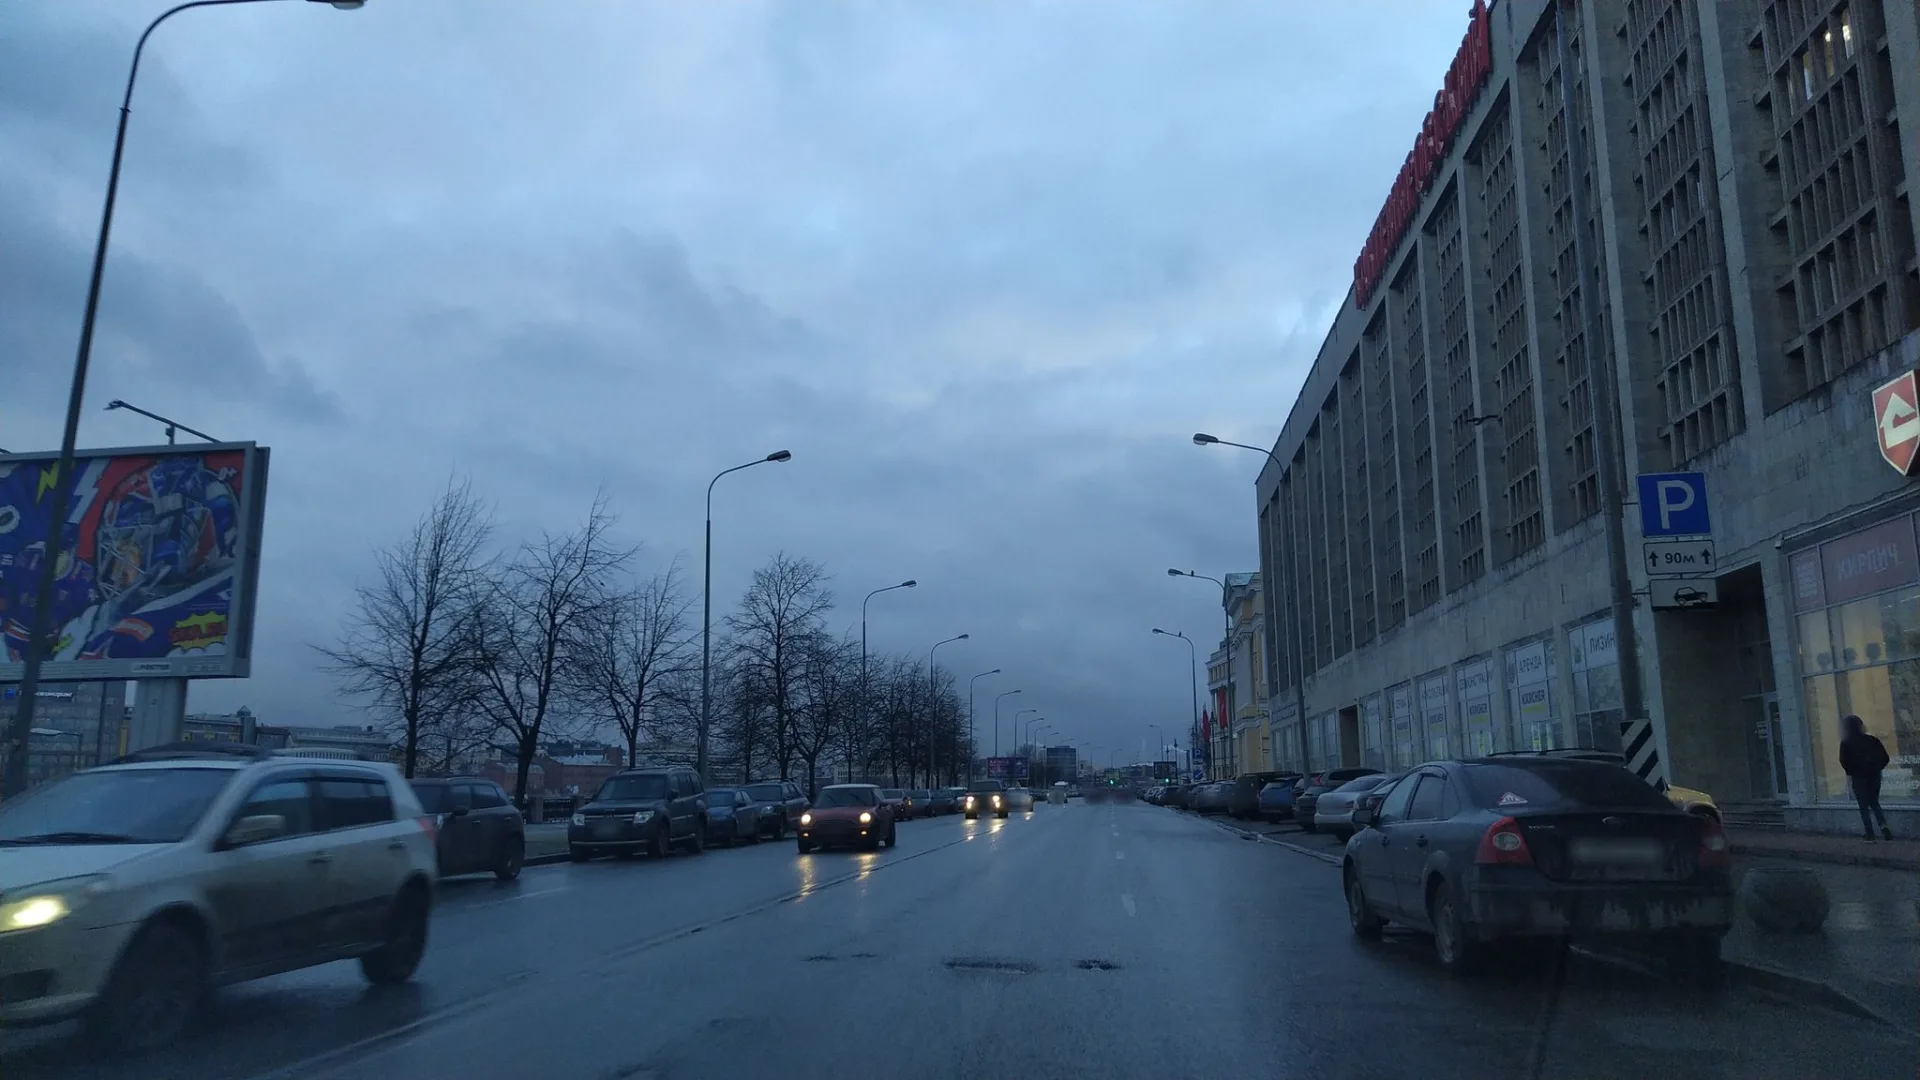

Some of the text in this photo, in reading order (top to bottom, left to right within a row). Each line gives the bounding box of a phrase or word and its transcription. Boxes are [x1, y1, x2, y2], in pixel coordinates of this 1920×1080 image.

[1657, 480, 1695, 529] P
[1837, 543, 1899, 581] КИРПИЧ
[1589, 632, 1616, 653] ЛИЗИН
[1518, 655, 1542, 673] АРЕНДА
